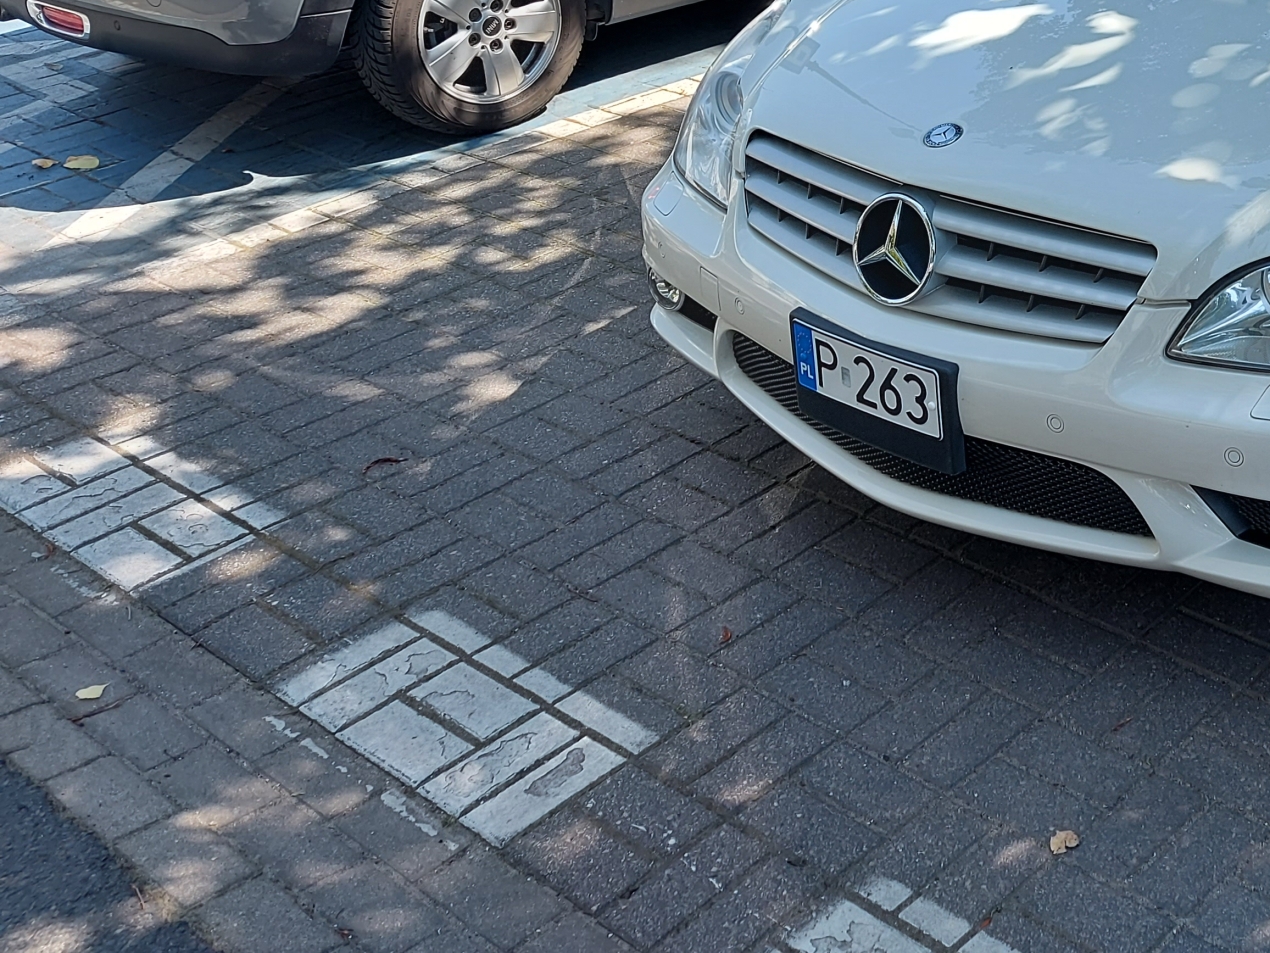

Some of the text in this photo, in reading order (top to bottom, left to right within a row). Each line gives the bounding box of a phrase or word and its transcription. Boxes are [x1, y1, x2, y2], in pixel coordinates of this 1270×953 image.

[800, 362, 814, 380] PL
[814, 337, 929, 425] P 263
